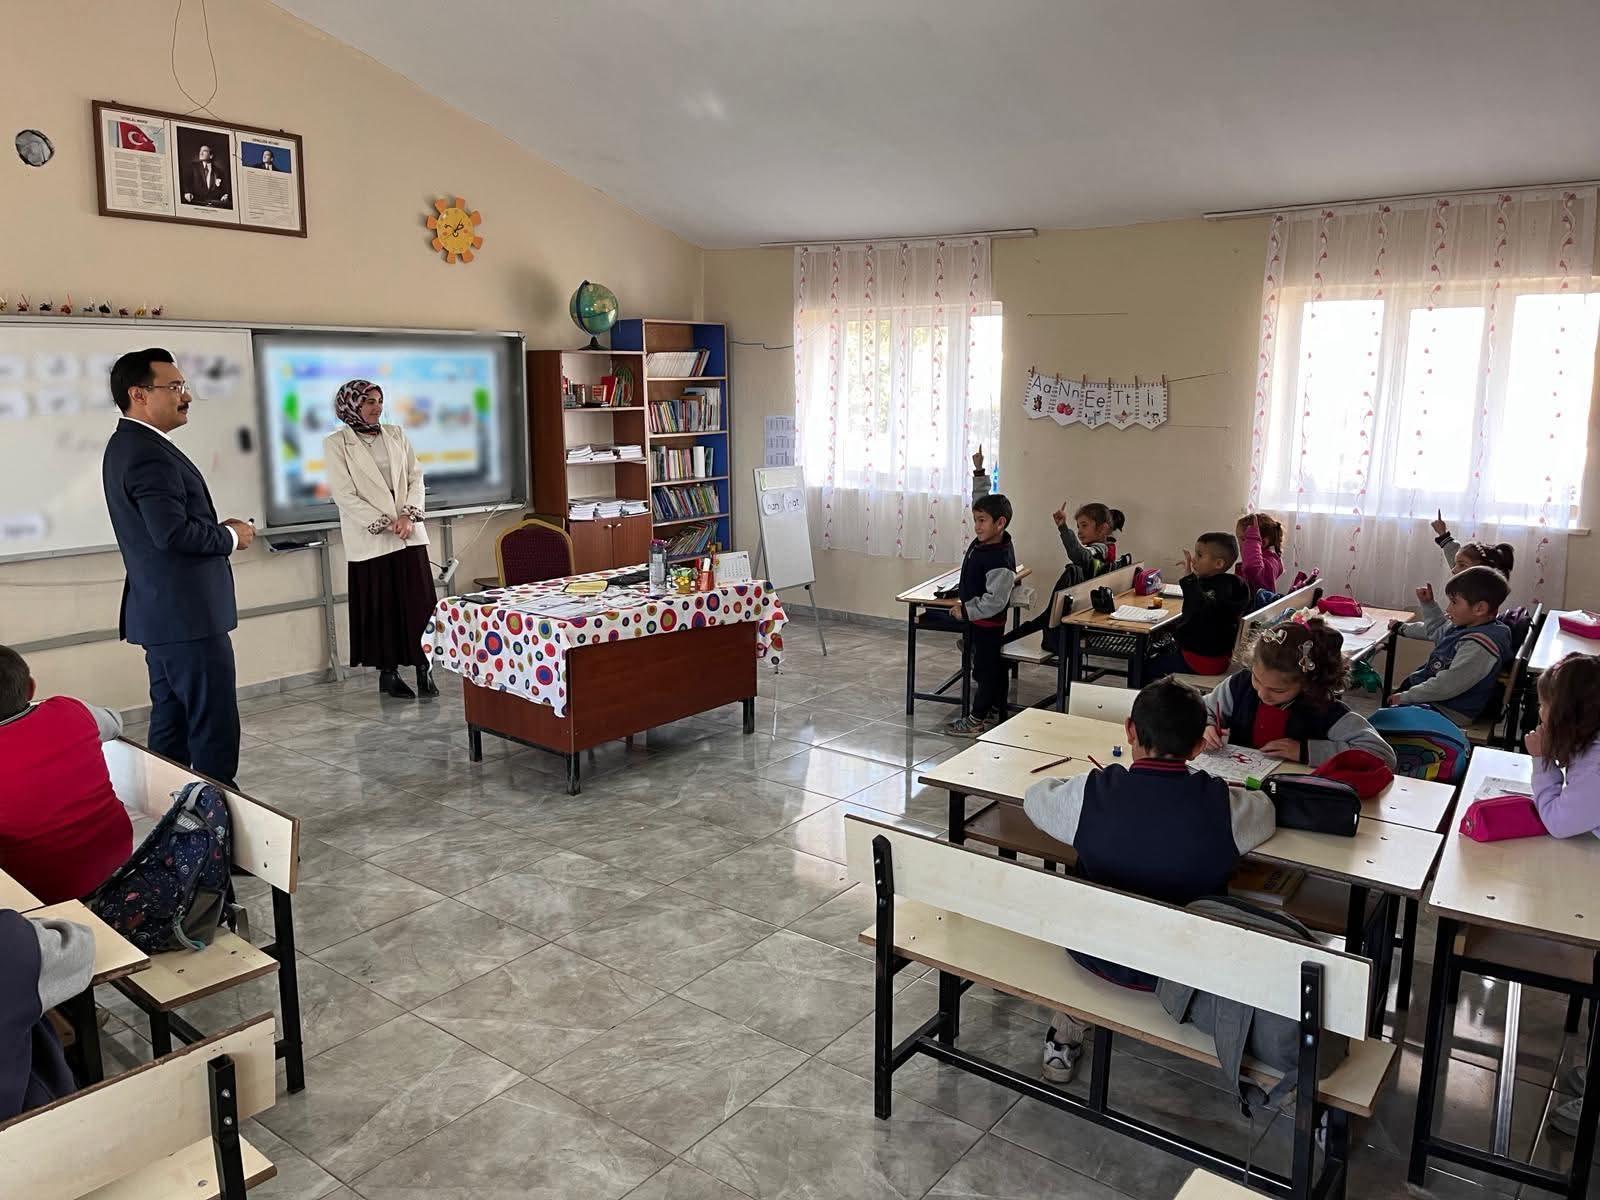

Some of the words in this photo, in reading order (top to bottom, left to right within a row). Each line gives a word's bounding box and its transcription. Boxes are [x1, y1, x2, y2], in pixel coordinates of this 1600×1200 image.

[1032, 375, 1052, 394] Aa
[1059, 382, 1080, 398] Nn
[1085, 390, 1106, 408] Ee
[1114, 390, 1131, 406] Tt
